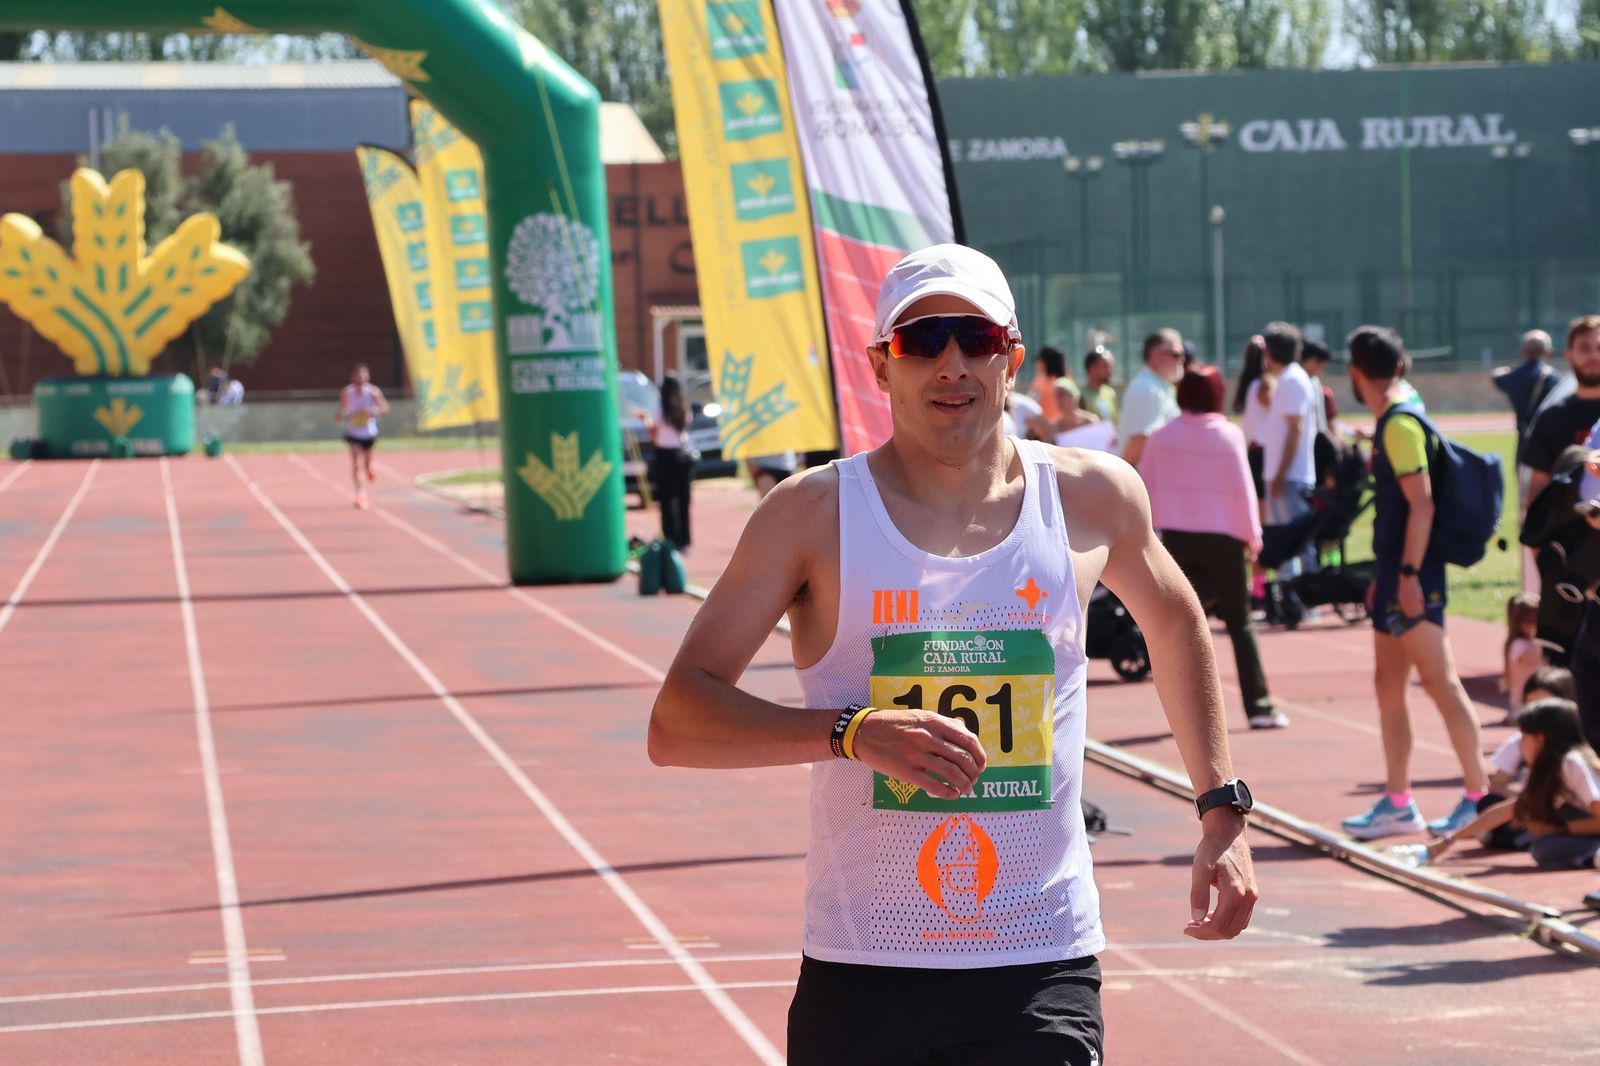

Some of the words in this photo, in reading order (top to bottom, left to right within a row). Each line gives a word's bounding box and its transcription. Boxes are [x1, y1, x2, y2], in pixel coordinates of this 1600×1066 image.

[1239, 118, 1347, 153] CAJA
[1360, 113, 1517, 149] RURAL
[966, 136, 1068, 162] ZAMORA
[923, 651, 957, 665] CAJA
[960, 650, 1006, 664] RURAL
[923, 665, 935, 673] DE
[937, 665, 970, 673] ZAMORA
[982, 779, 1042, 798] RURAL
